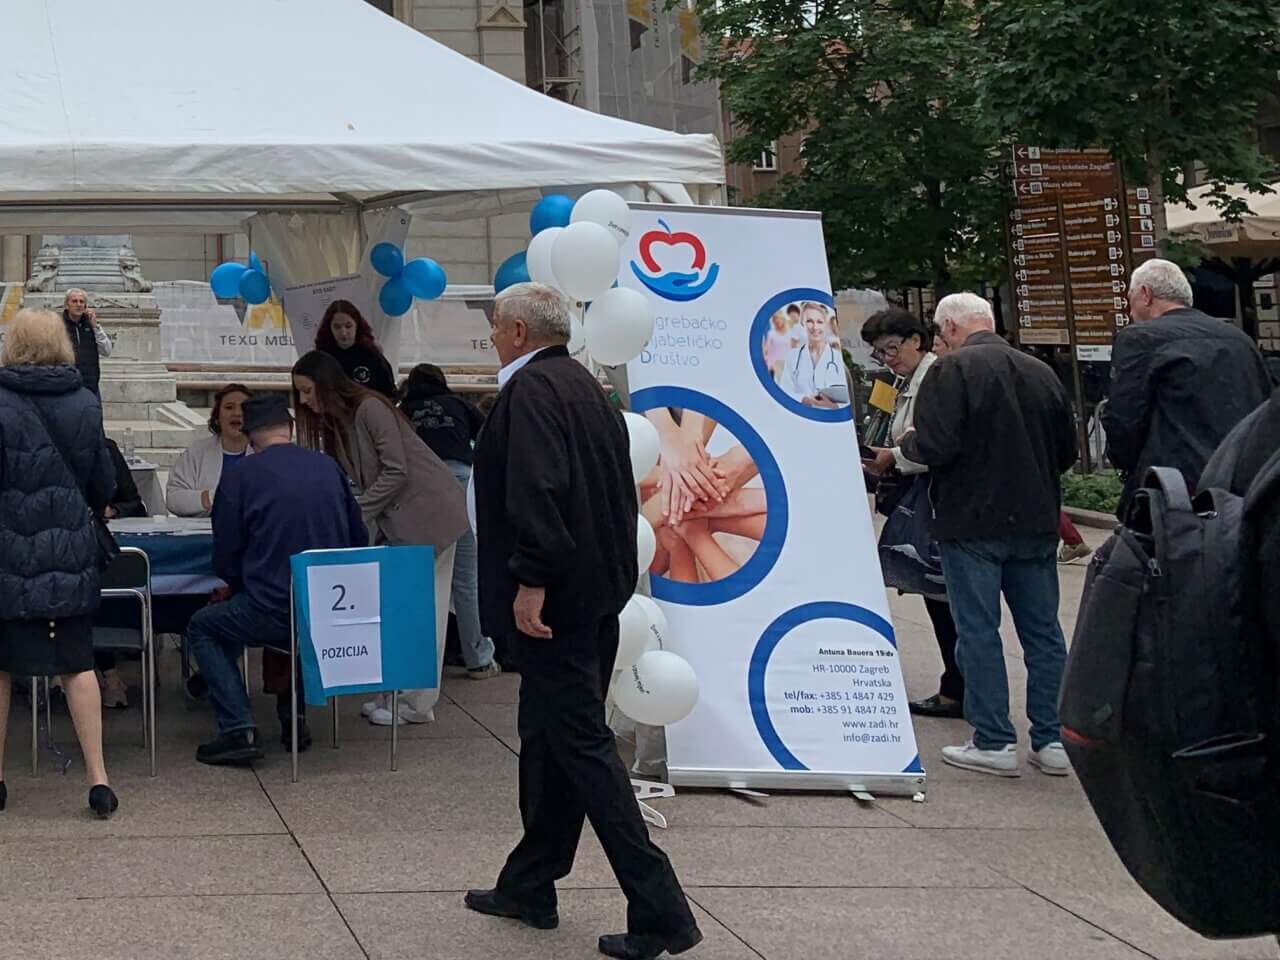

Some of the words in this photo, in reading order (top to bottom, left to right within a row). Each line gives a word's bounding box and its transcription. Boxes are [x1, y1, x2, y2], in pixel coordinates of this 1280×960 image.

[655, 315, 727, 330] grebačko
[219, 335, 258, 346] TEXO
[640, 350, 700, 367] Društvo
[332, 584, 355, 611] 2.
[321, 645, 369, 660] POZICIJA
[818, 648, 845, 656] Antuna
[812, 664, 857, 674] HR-10000
[859, 665, 889, 676] Zagreb
[852, 678, 892, 688] Hrvatska
[784, 690, 818, 701] tel/fax:
[819, 691, 842, 701] +385
[844, 692, 850, 700] 1
[852, 692, 875, 701] 4847
[877, 692, 895, 701] 429
[790, 704, 814, 714] mob:
[816, 705, 839, 714] +385
[840, 705, 852, 714] 91
[854, 705, 877, 715] 4847
[879, 706, 897, 715] 429
[842, 720, 899, 729] www.zadi.hr
[843, 733, 901, 743] info@zadi.hr
